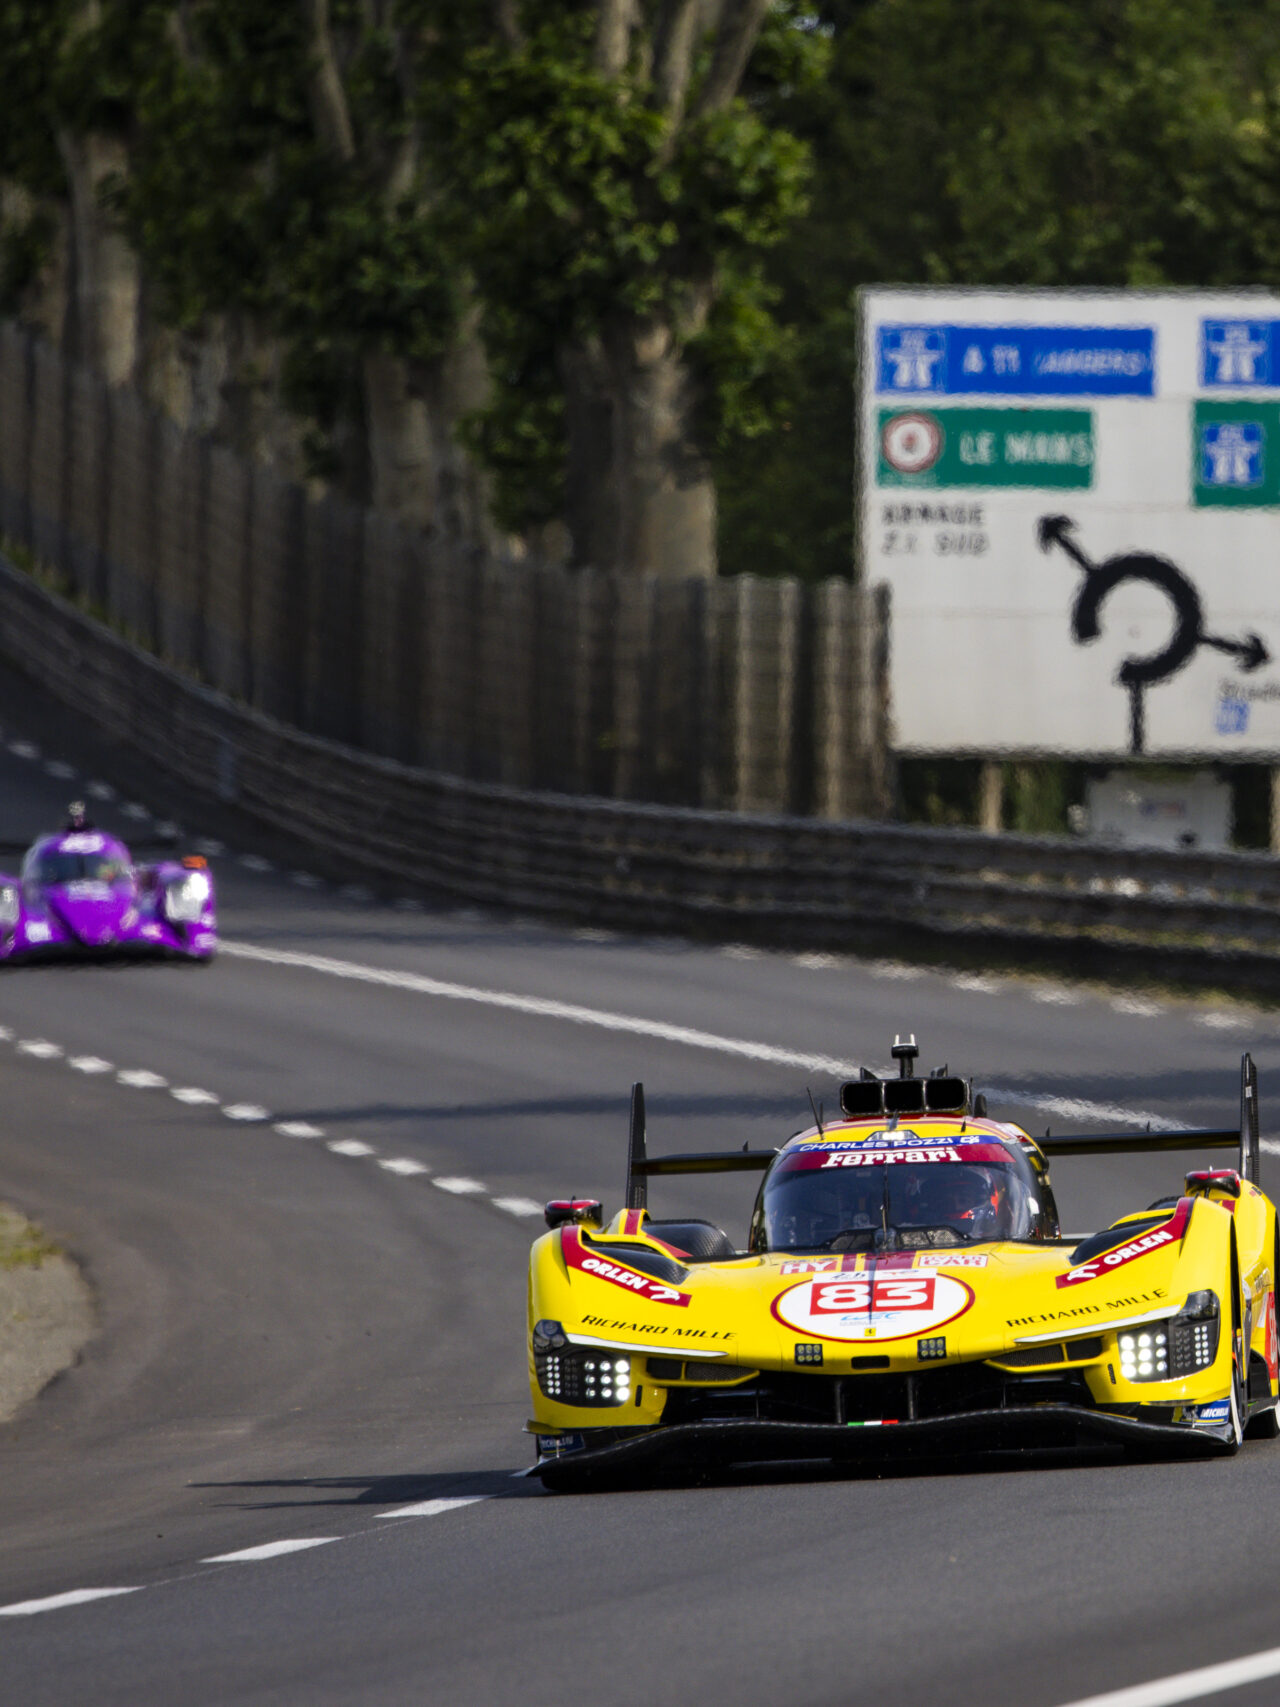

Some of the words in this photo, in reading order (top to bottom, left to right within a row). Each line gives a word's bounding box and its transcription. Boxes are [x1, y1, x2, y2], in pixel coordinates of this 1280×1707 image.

[960, 431, 995, 465] LE
[800, 1141, 888, 1151] CHARLES
[893, 1137, 953, 1147] POZZI
[821, 1147, 962, 1168] Ferrari
[1103, 1230, 1174, 1265] ORLEN
[581, 1258, 649, 1290] ORLEN
[817, 1281, 928, 1310] 83
[1006, 1305, 1100, 1328] RICHARD
[1106, 1288, 1168, 1310] MILLE
[581, 1314, 669, 1335] RICHARD
[673, 1328, 738, 1340] MILLE
